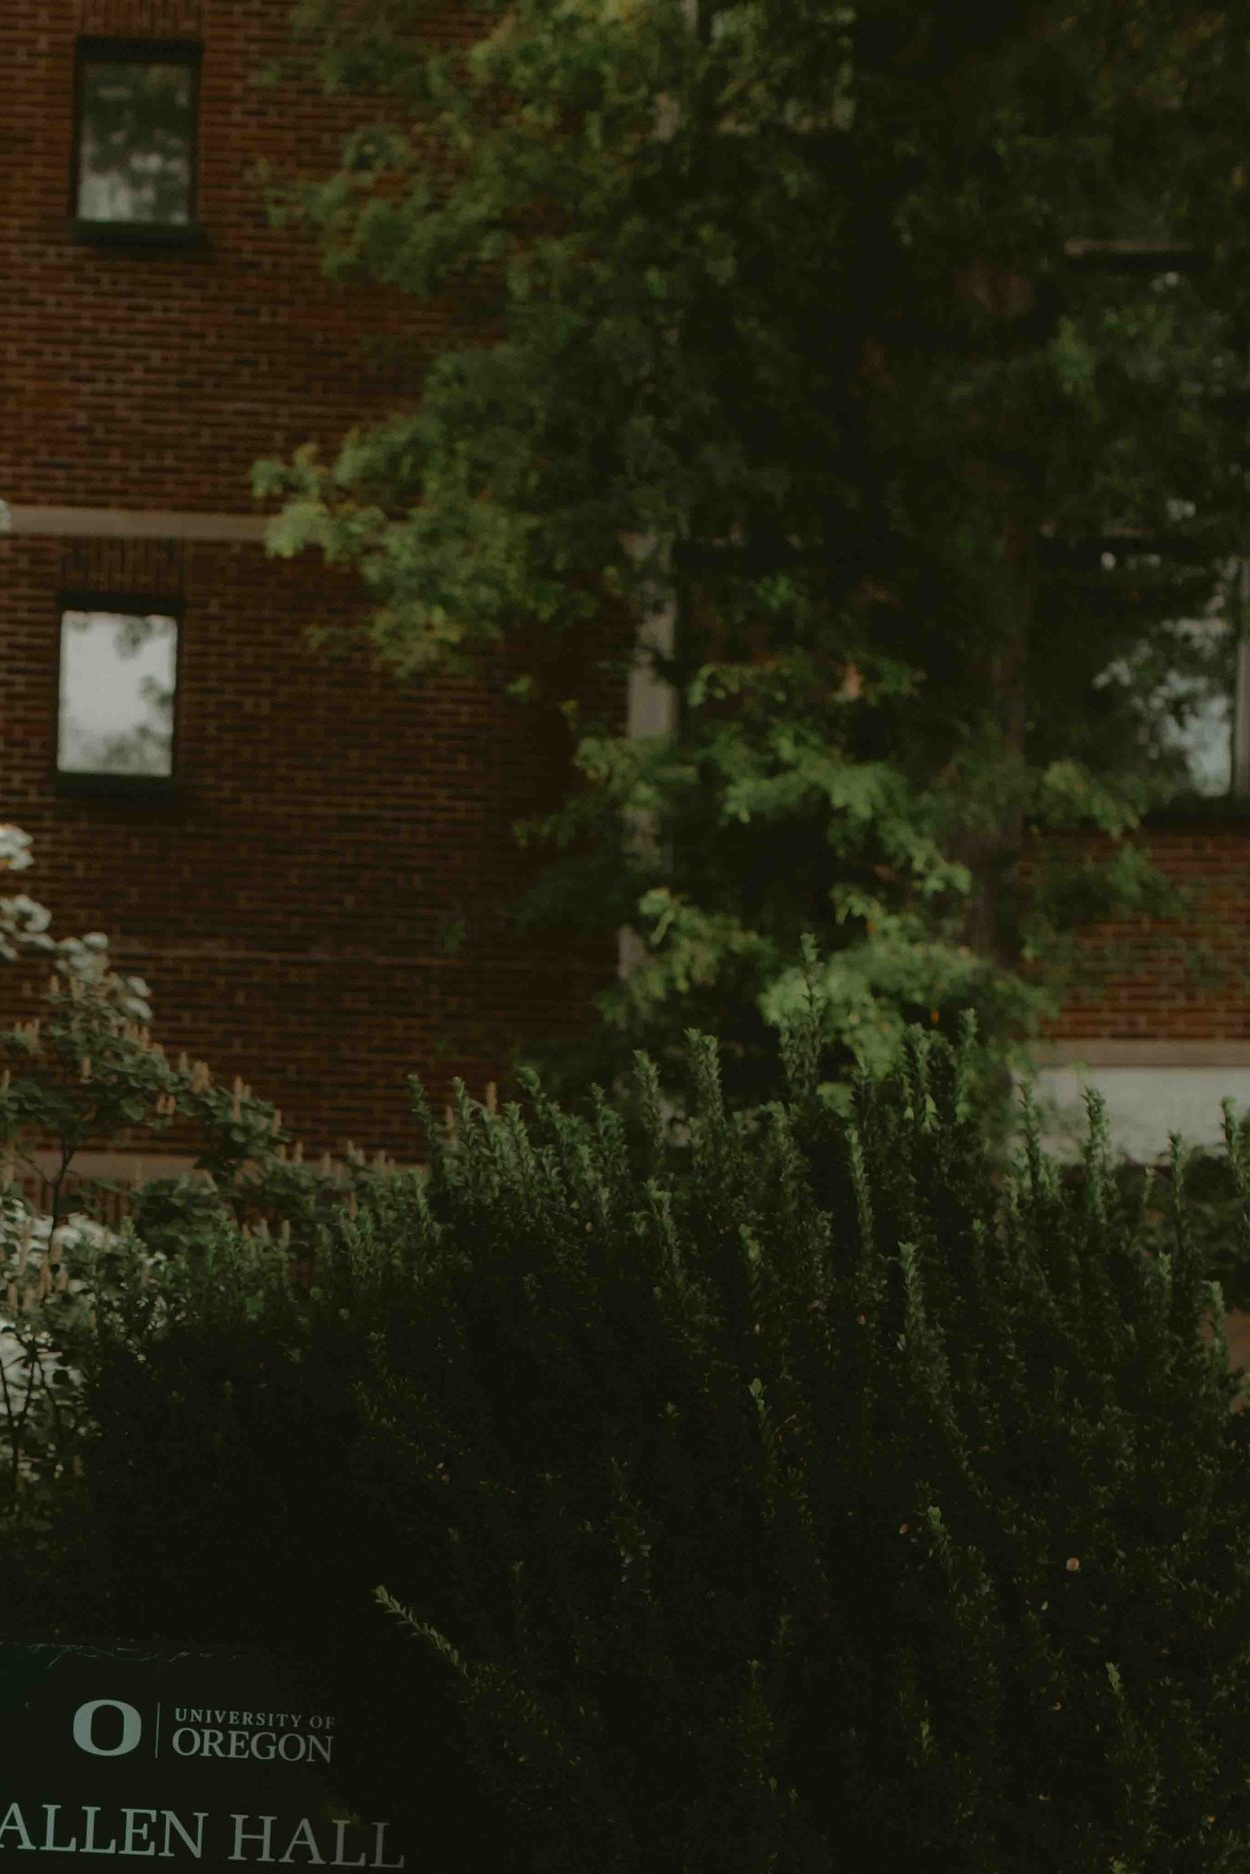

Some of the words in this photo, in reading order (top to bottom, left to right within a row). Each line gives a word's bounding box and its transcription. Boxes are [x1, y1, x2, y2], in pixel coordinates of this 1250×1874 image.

[73, 1699, 142, 1757] O
[174, 1708, 303, 1729] UNIVERSITY
[308, 1714, 336, 1730] OF
[172, 1728, 335, 1764] OREGON
[227, 1814, 406, 1869] HALL
